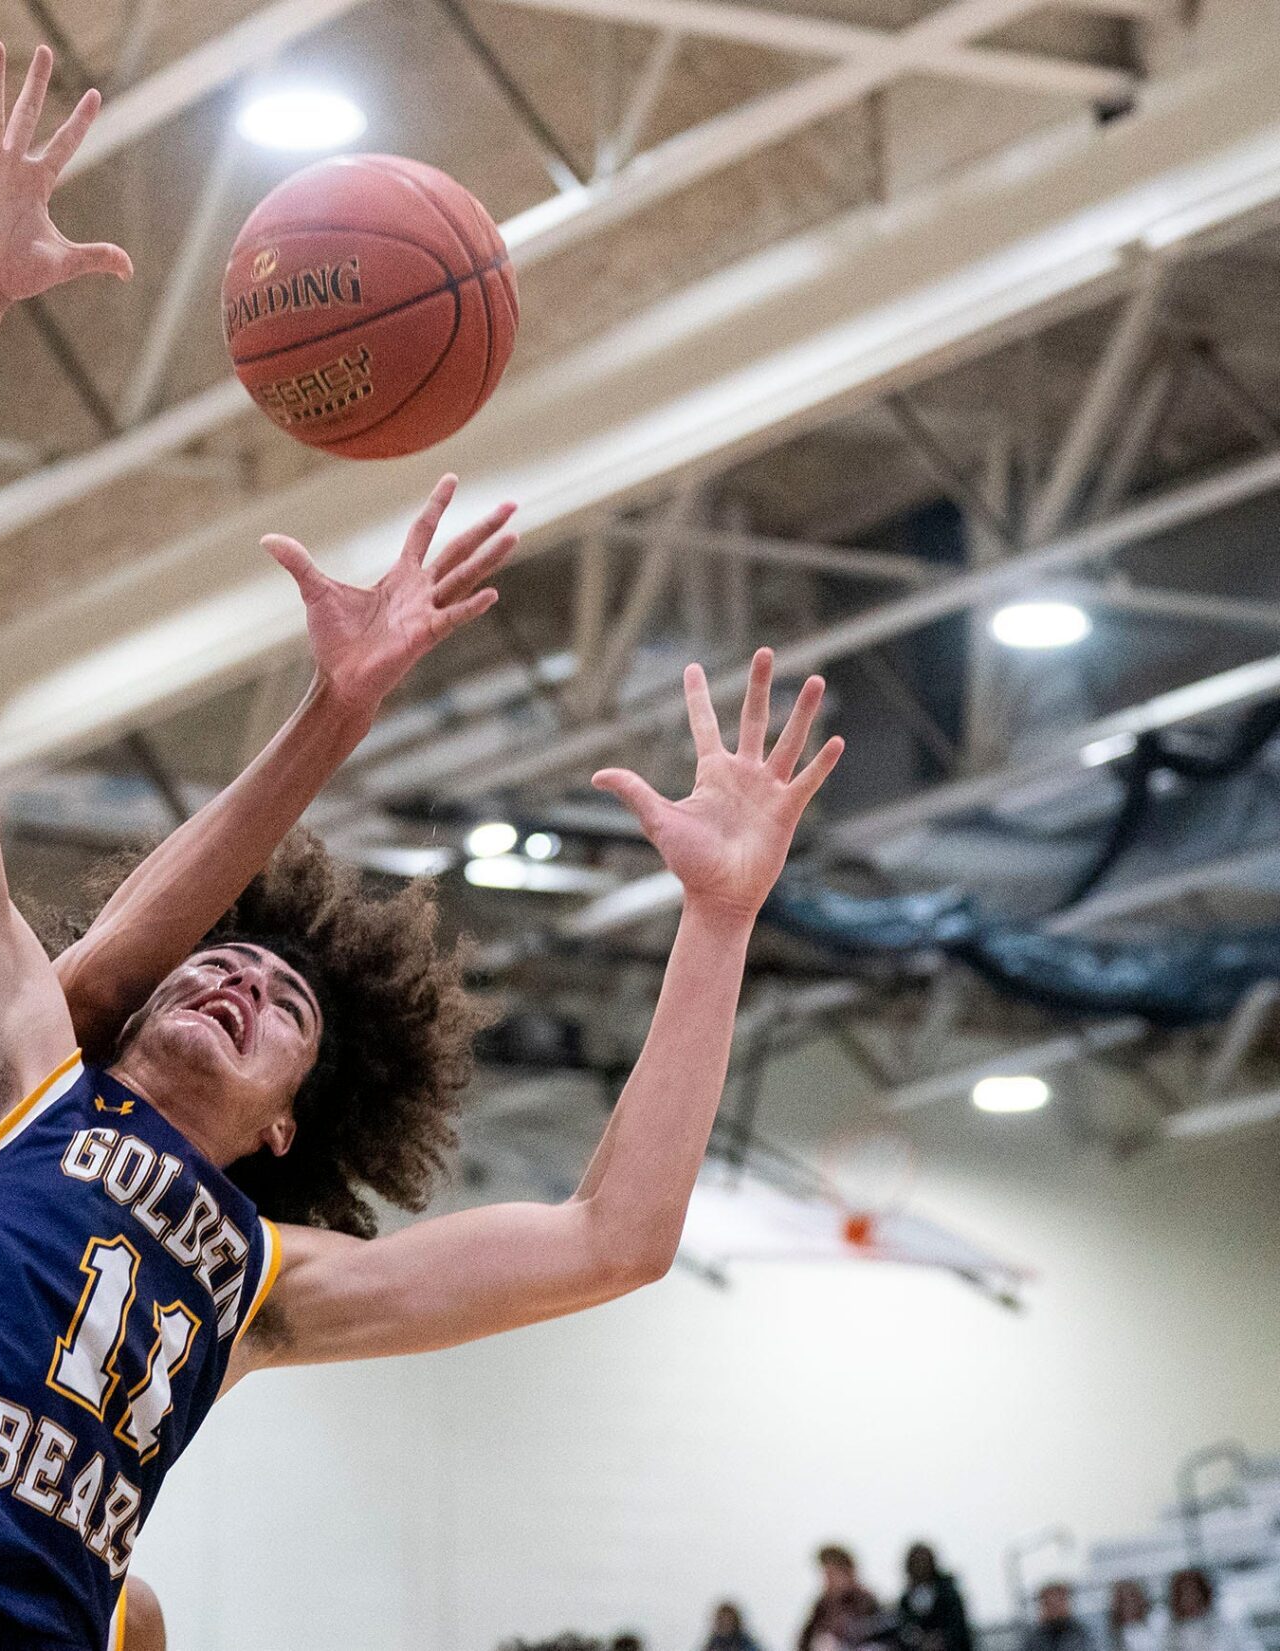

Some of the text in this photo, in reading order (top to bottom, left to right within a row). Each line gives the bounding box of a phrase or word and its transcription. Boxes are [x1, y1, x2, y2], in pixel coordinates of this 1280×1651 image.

[225, 255, 363, 342] PALDING
[259, 344, 373, 411] EGACY
[46, 1234, 202, 1466] 11
